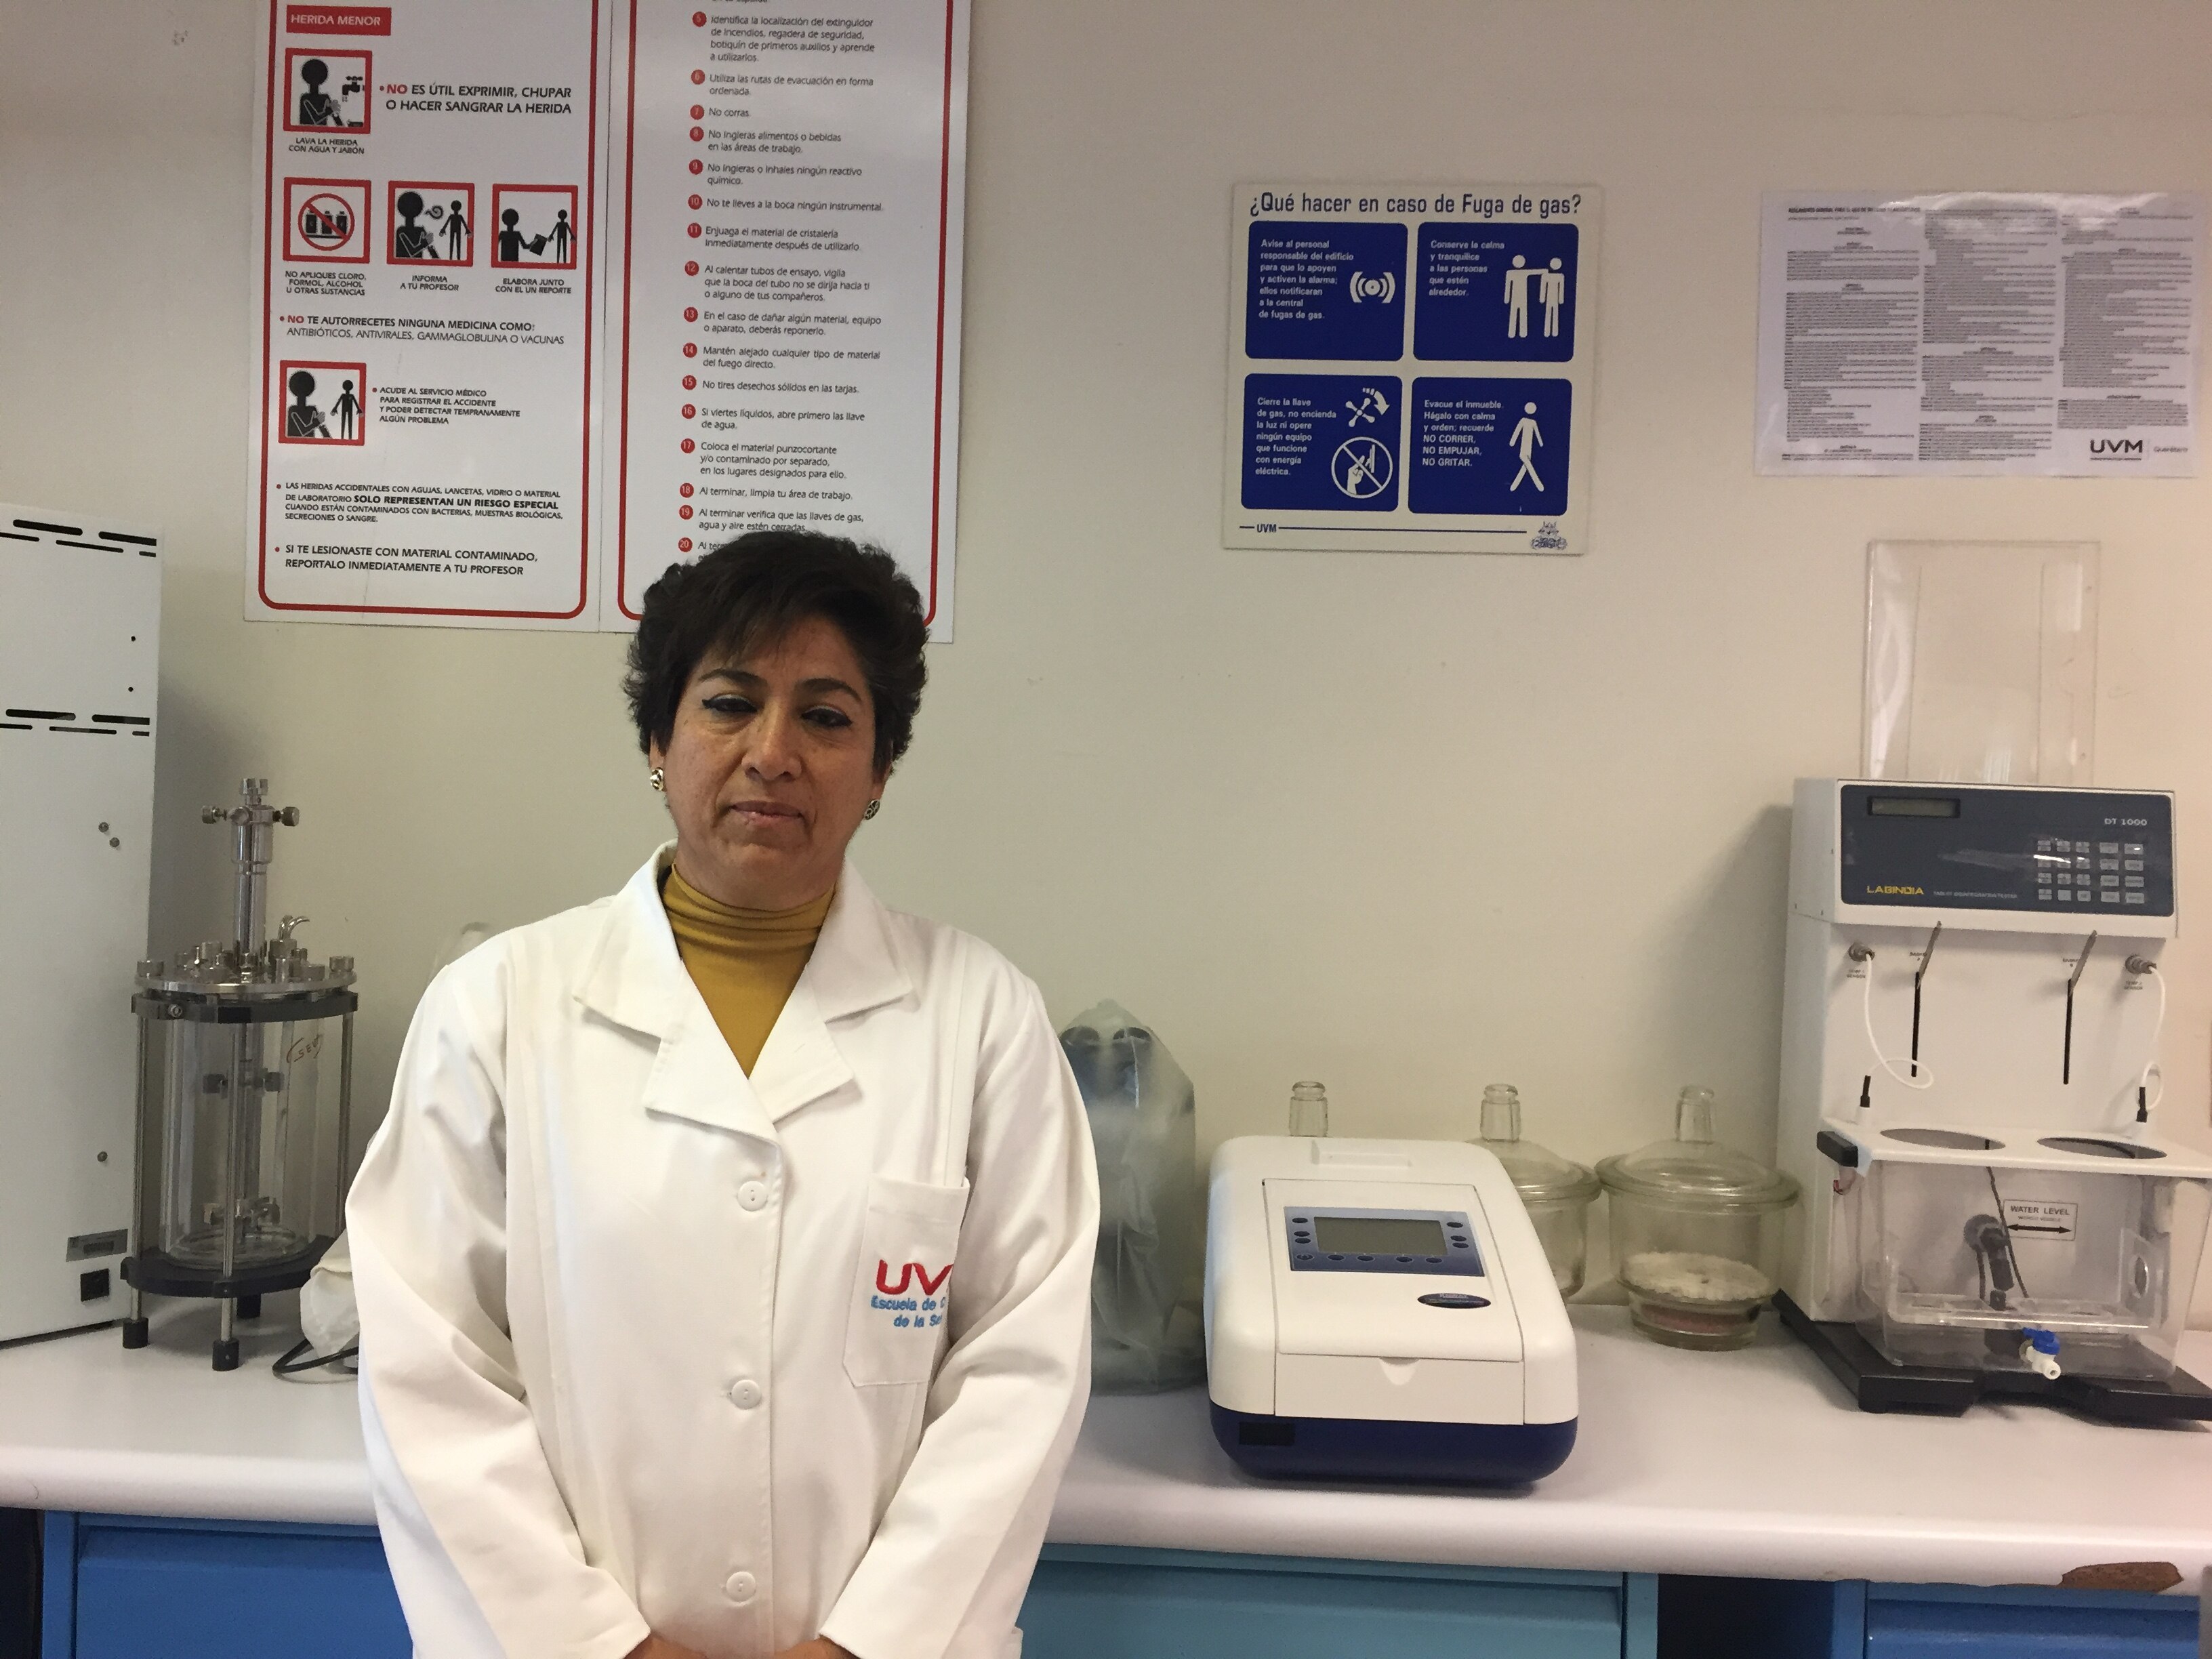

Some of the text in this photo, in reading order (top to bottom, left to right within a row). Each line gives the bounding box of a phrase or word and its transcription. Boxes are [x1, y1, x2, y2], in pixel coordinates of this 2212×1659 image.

[291, 14, 381, 26] HERIDA MENOR
[386, 82, 571, 98] NO ES ÚTIL EXPRIMIR, CHUPAR
[386, 99, 571, 114] O HACER SANGRAR LA HERIDA
[295, 138, 316, 146] LAVA
[329, 138, 358, 147] HERIDA
[308, 145, 331, 153] AGUA
[337, 145, 365, 155] JABÓN
[1250, 192, 1581, 219] ¿Qué hacer en caso de Fuga de gas?
[1261, 239, 1330, 249] Avise al personal
[1431, 239, 1504, 249] Conserve la calma
[1261, 251, 1354, 261] responsable del edificio
[411, 274, 448, 284] INFORMA
[503, 277, 537, 287] ELABORA
[408, 282, 417, 290] TU
[419, 283, 459, 291] PROFESOR
[495, 285, 512, 293] CON
[538, 286, 571, 294] REPORTE
[703, 310, 715, 320] En
[717, 311, 724, 320] el
[726, 313, 746, 321] caso
[748, 312, 759, 321] de
[761, 312, 785, 323] dañar
[787, 312, 811, 325] algún
[852, 316, 881, 327] equipo
[1258, 309, 1269, 318] de
[1271, 309, 1294, 321] fugas
[1295, 310, 1306, 319] de
[287, 314, 535, 331] NO TE AUTORRECETES NINGUNA MEDICINA COMO:
[286, 326, 564, 345] ANTIBIÓTICOS, ANTIVIRALES, GAMMAGLOBULINA O VACUNAS
[702, 380, 715, 389] No
[717, 381, 735, 390] tires
[737, 381, 776, 391] desechos
[777, 382, 806, 392] sólidos
[821, 384, 833, 392] las
[1257, 396, 1311, 406] Cierre la llave
[1424, 399, 1454, 408] Evacue
[1455, 400, 1463, 408] el
[1424, 411, 1452, 422] Hágalo
[1471, 412, 1495, 420] calma
[1423, 424, 1429, 432] y
[1459, 423, 1494, 432] recuerde
[1422, 434, 1436, 443] NO
[701, 441, 729, 451] Coloca
[731, 443, 739, 451] el
[741, 443, 775, 452] material
[776, 445, 837, 455] punzocortante
[1422, 446, 1435, 454] NO
[2090, 439, 2143, 453] UVM
[1422, 457, 1435, 466] NO
[699, 487, 708, 495] Al
[750, 488, 775, 499] limpia
[788, 489, 806, 499] área
[808, 490, 819, 499] de
[298, 494, 352, 502] LABORATORIO
[354, 495, 381, 504] SOLO
[384, 495, 454, 506] REPRESENTAN
[457, 498, 471, 506] UN
[474, 499, 510, 508] RIESGO
[513, 500, 558, 510] ESPECIAL
[699, 508, 708, 516] Al
[710, 508, 744, 518] terminar
[746, 510, 775, 519] verifica
[777, 512, 794, 521] que
[796, 512, 807, 520] las
[809, 512, 832, 520] llaves
[834, 512, 844, 521] de
[1256, 523, 1279, 533] UVM
[285, 544, 537, 562] SI TE LESIONASTE CON MATERIAL CONTAMINADO,
[285, 558, 523, 575] REPORTALO INMEDIATAMENTE A TU PROFESOR
[2121, 818, 2148, 826] 1000
[2010, 1205, 2070, 1215] WATER LEVEL
[876, 1259, 954, 1296] UV
[870, 1295, 918, 1311] Escuela
[922, 1297, 937, 1311] de
[893, 1315, 909, 1327] de
[914, 1315, 924, 1328] la
